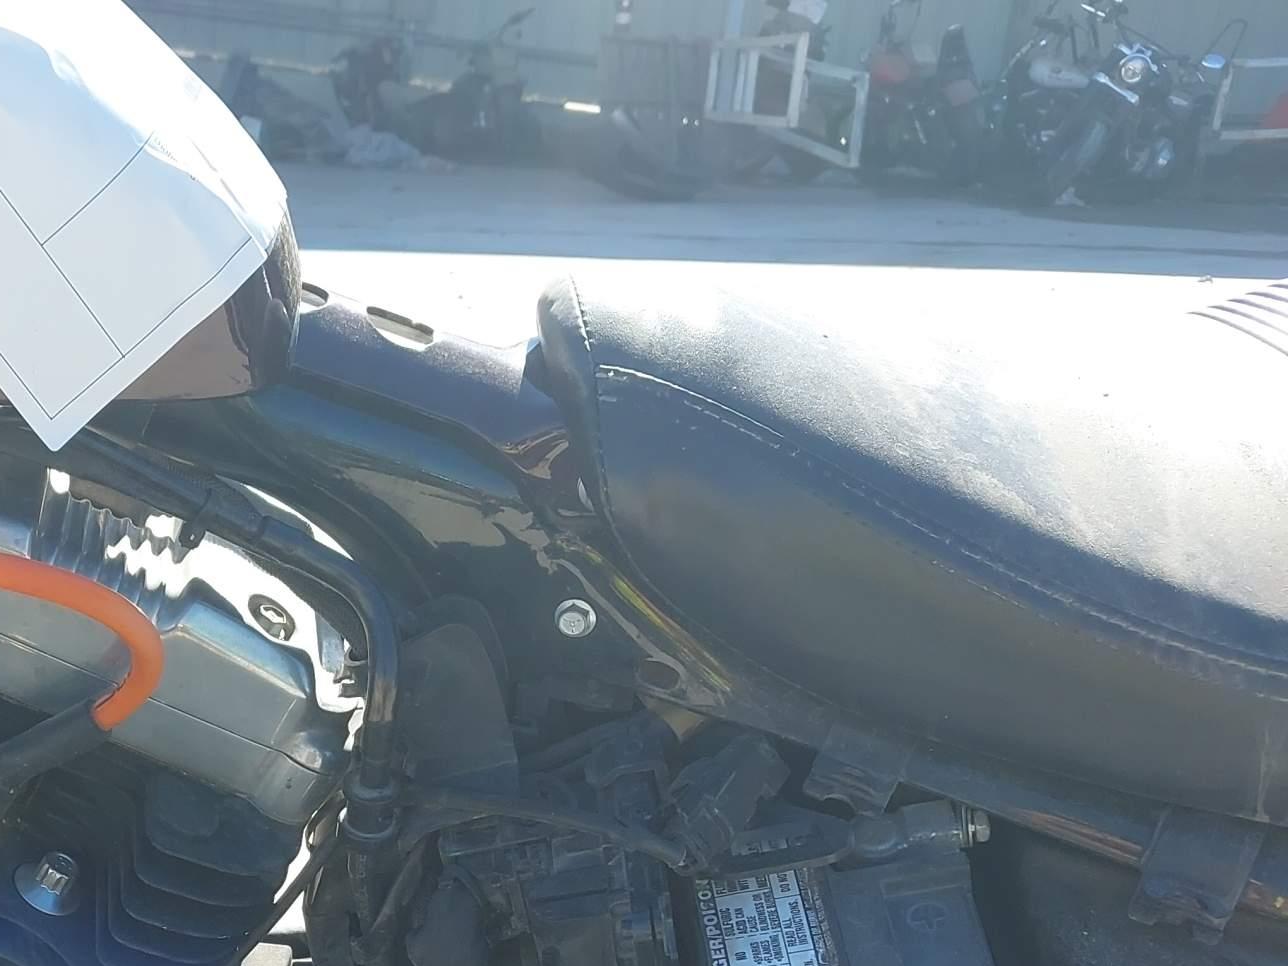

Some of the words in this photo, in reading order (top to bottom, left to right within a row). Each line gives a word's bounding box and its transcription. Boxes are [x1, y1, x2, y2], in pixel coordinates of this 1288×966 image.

[779, 883, 791, 893] DO
[734, 908, 745, 919] CAN
[754, 902, 769, 931] BLINDNESS
[767, 909, 781, 929] SEVERE
[719, 908, 735, 937] SULFURIC
[735, 919, 748, 934] ACID
[746, 916, 759, 933] CAUSE
[782, 918, 793, 929] ALL
[785, 930, 797, 947] READ
[734, 951, 747, 961] NO
